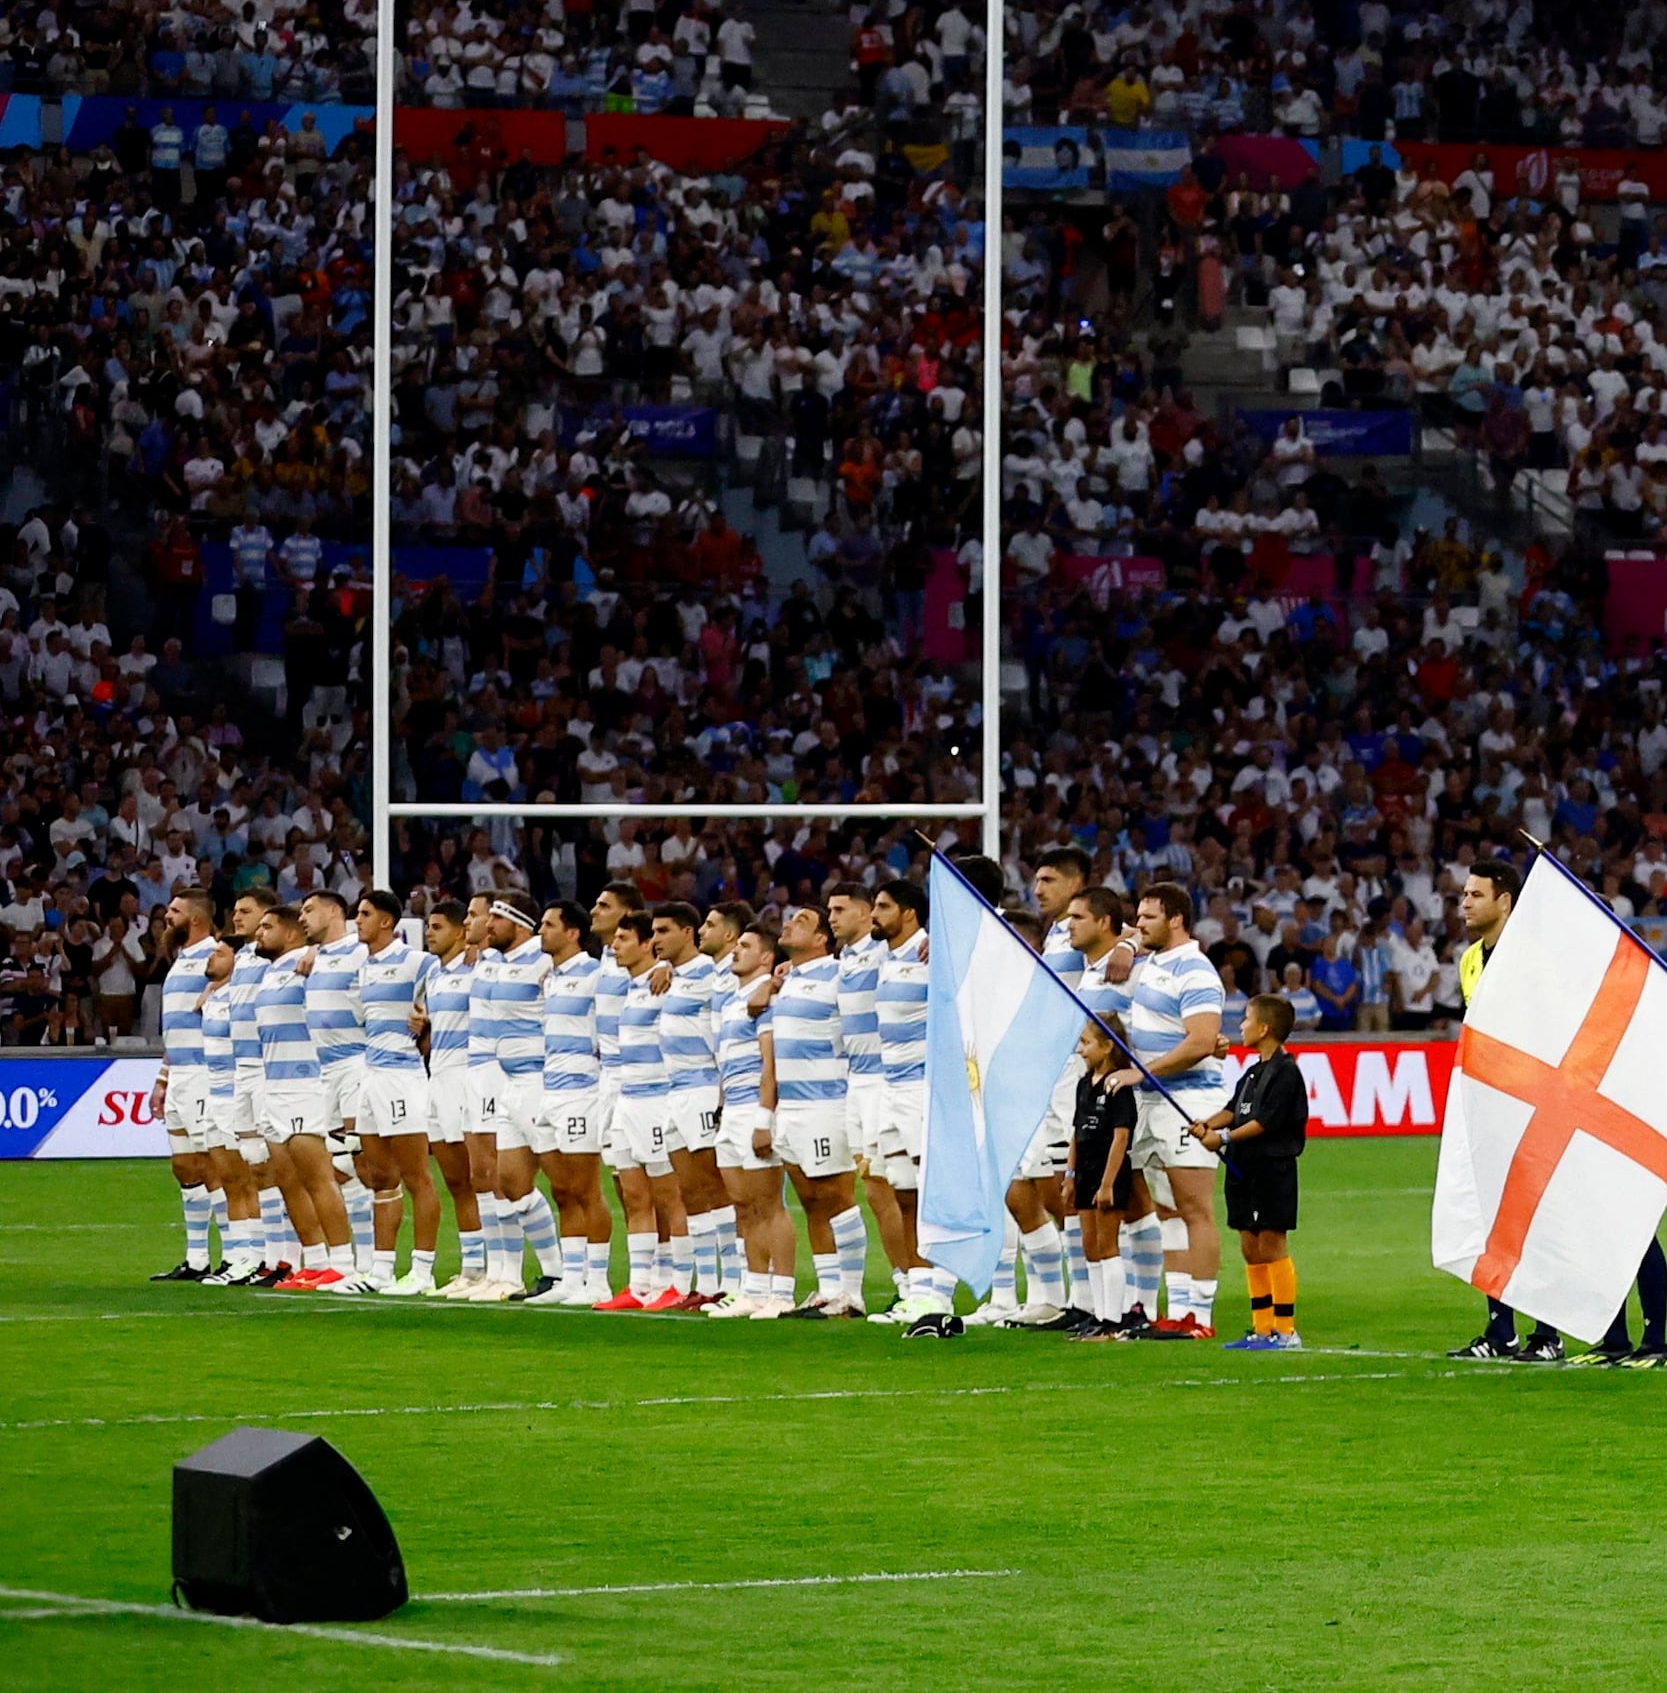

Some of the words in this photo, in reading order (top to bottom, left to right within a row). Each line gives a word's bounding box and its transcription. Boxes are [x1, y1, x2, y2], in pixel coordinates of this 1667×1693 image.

[196, 1099, 205, 1116] 7
[391, 1100, 406, 1118] 13
[482, 1097, 495, 1115] 14
[291, 1117, 303, 1133] 17
[567, 1117, 586, 1135] 23
[653, 1127, 664, 1145] 9
[813, 1138, 831, 1157] 16
